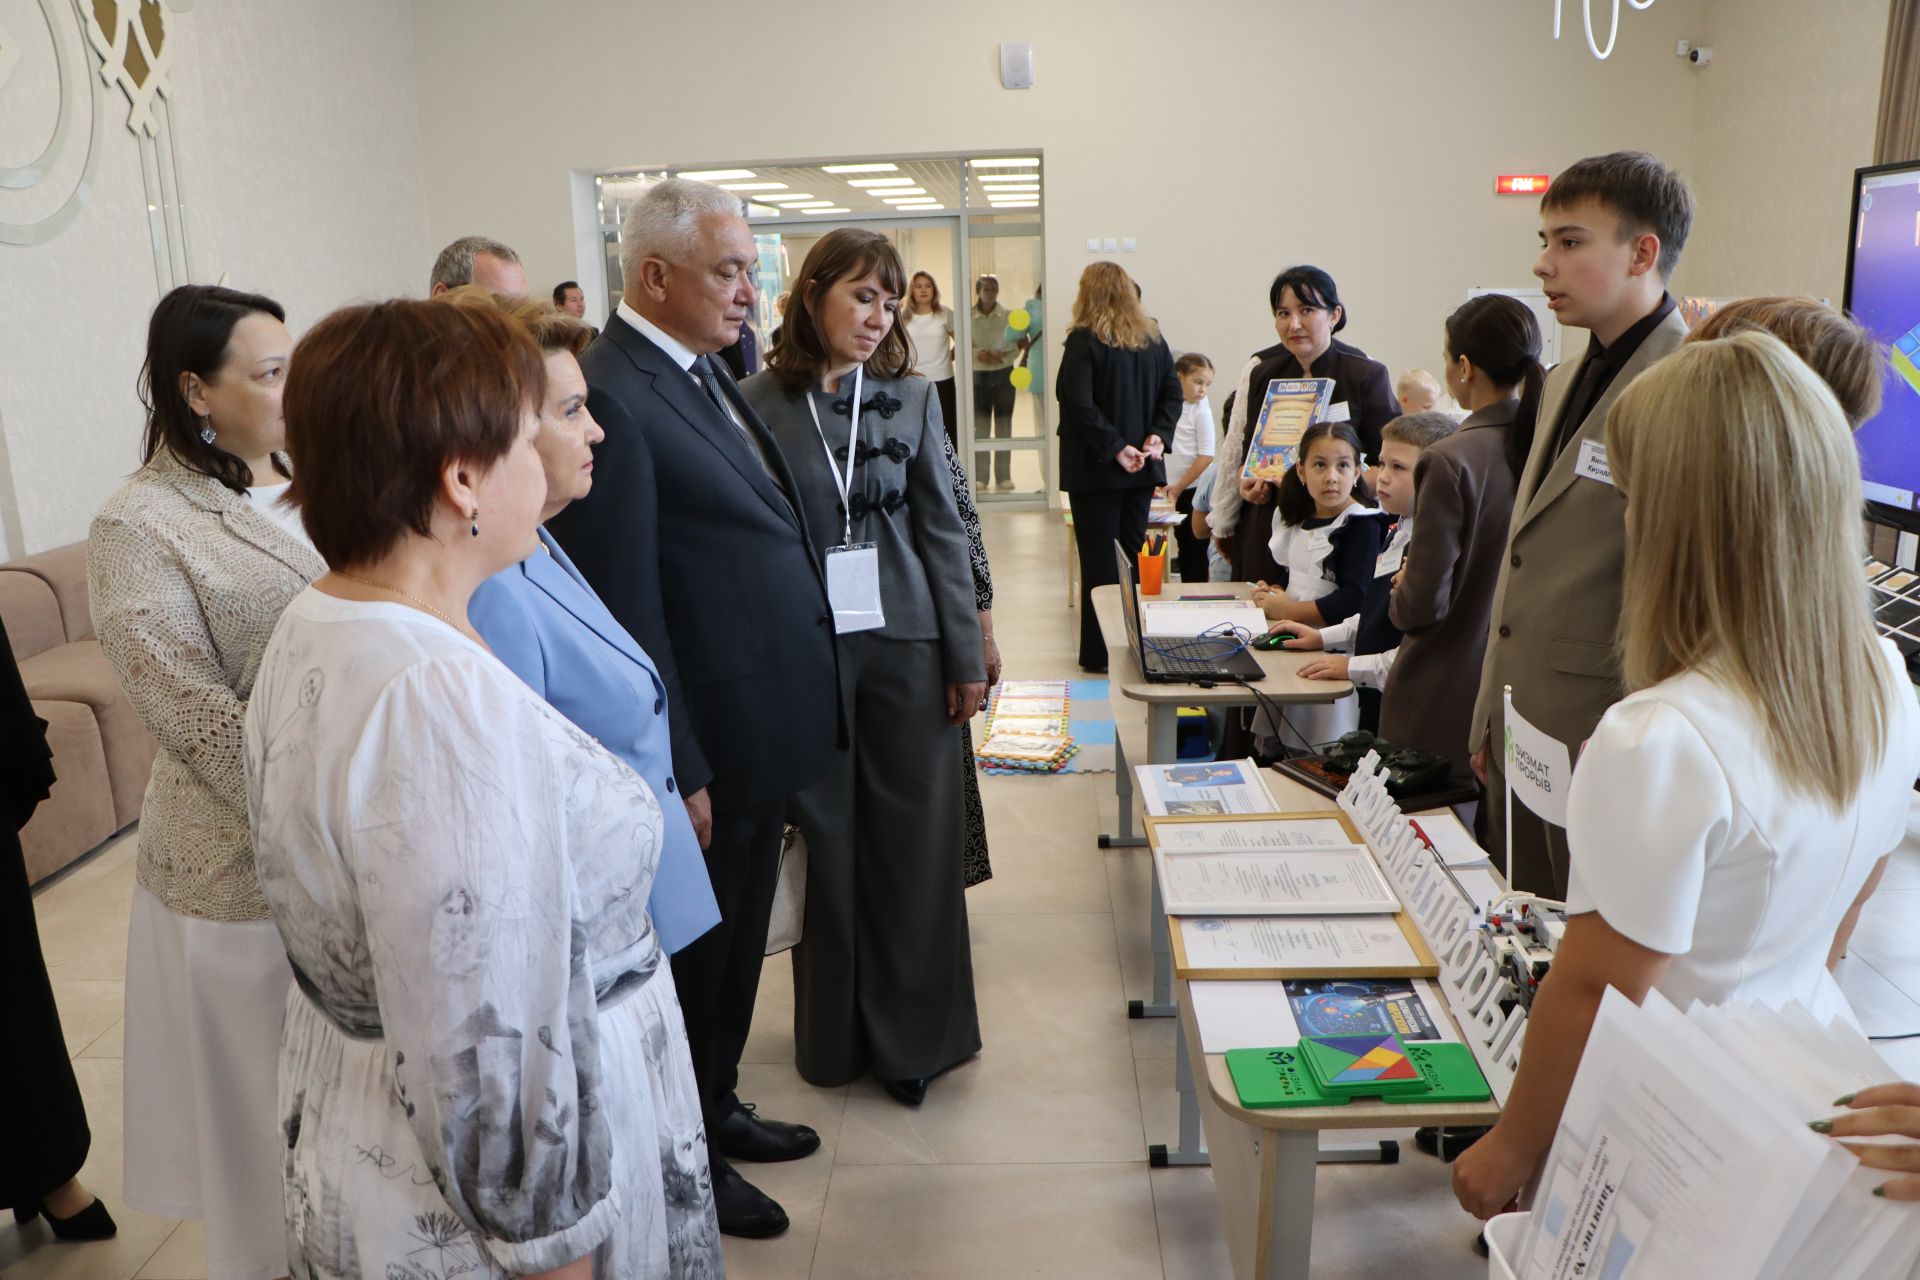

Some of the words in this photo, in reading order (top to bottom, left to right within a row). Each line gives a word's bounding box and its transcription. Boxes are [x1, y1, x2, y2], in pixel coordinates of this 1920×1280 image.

[1515, 743, 1550, 777] ФИЗМАТ
[1516, 756, 1552, 793] ПРОРЫВ
[1583, 1179, 1616, 1252] Занятие
[1573, 1252, 1586, 1276] №
